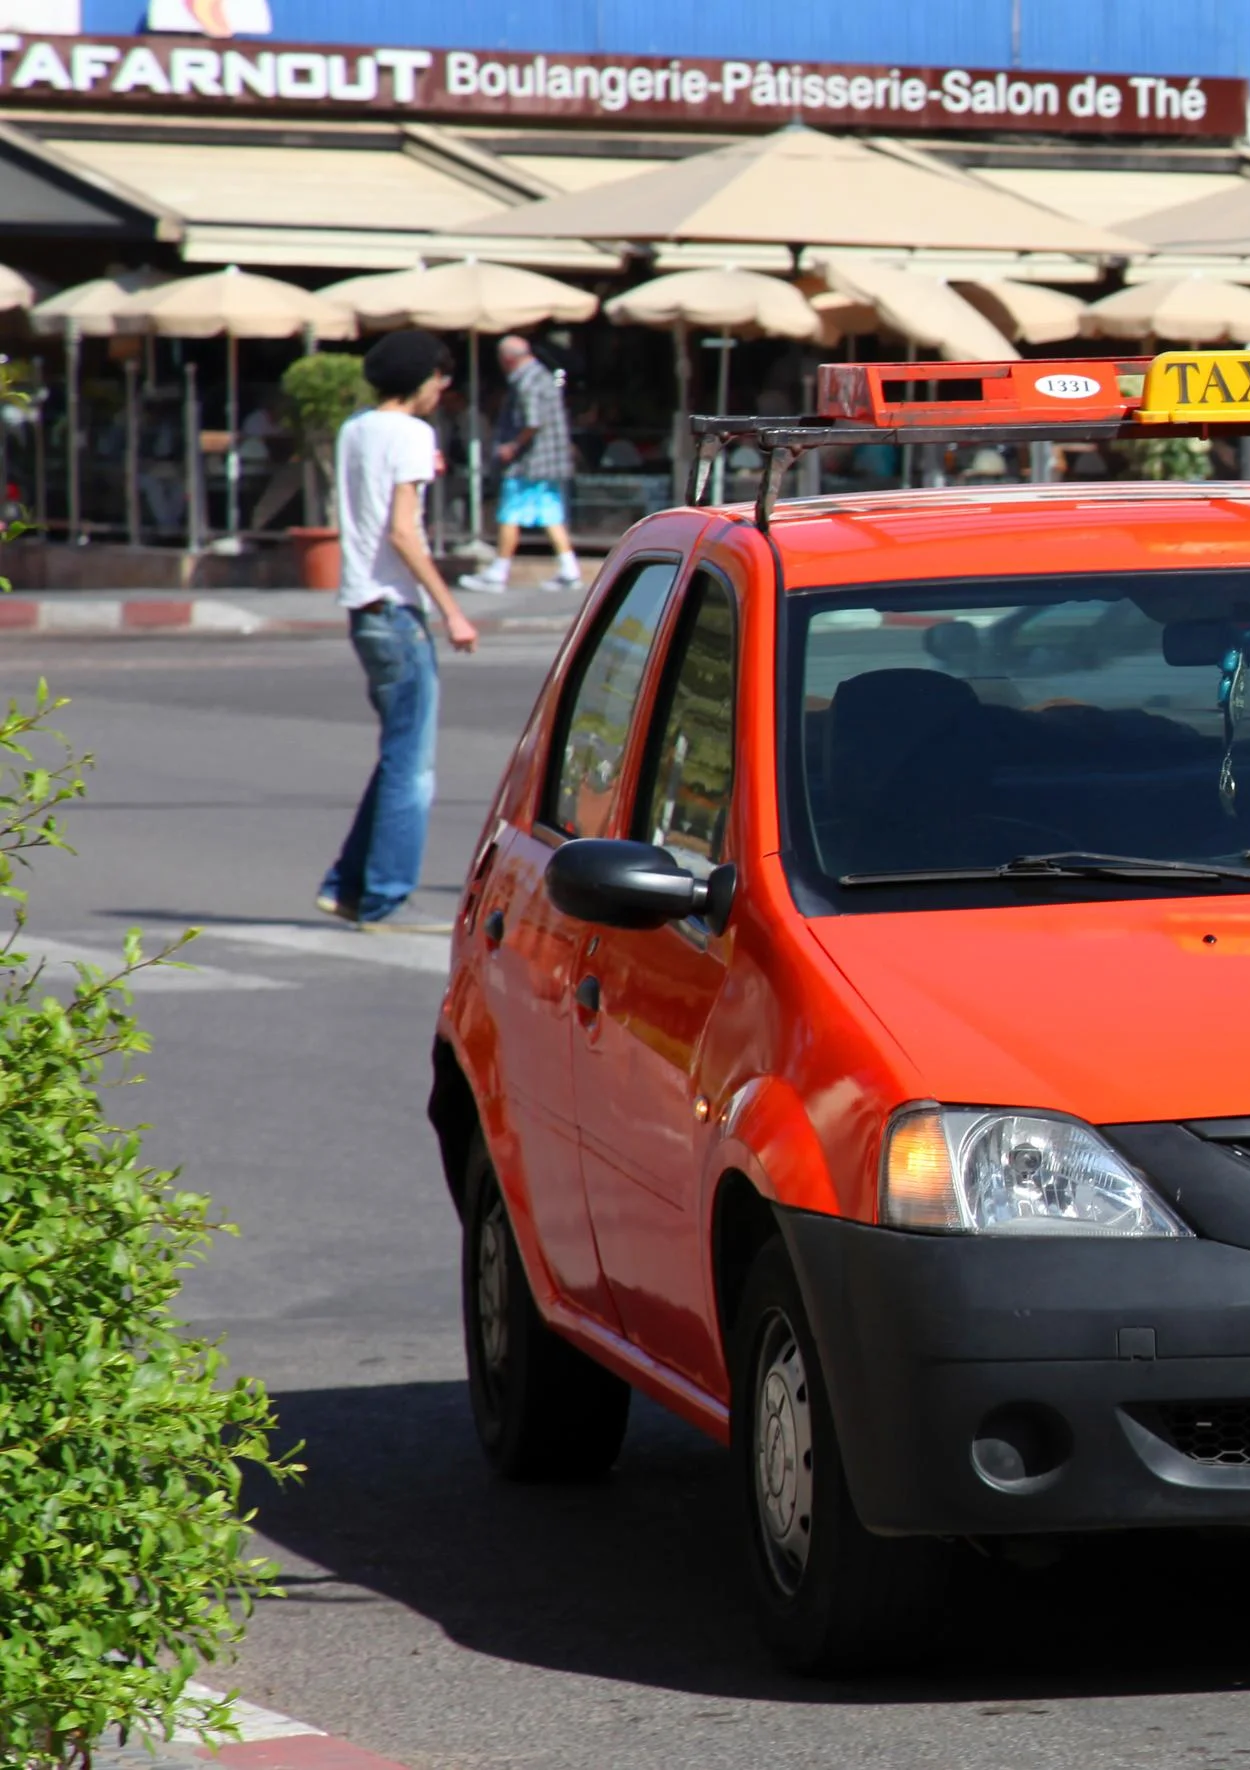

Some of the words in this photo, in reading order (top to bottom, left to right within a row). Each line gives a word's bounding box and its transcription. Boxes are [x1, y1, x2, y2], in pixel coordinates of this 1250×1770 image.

[446, 51, 1058, 115] Boulangerie-Pâtisserie-Salon
[1067, 76, 1121, 118] de
[1129, 77, 1207, 121] Thé
[1047, 379, 1090, 393] 1331
